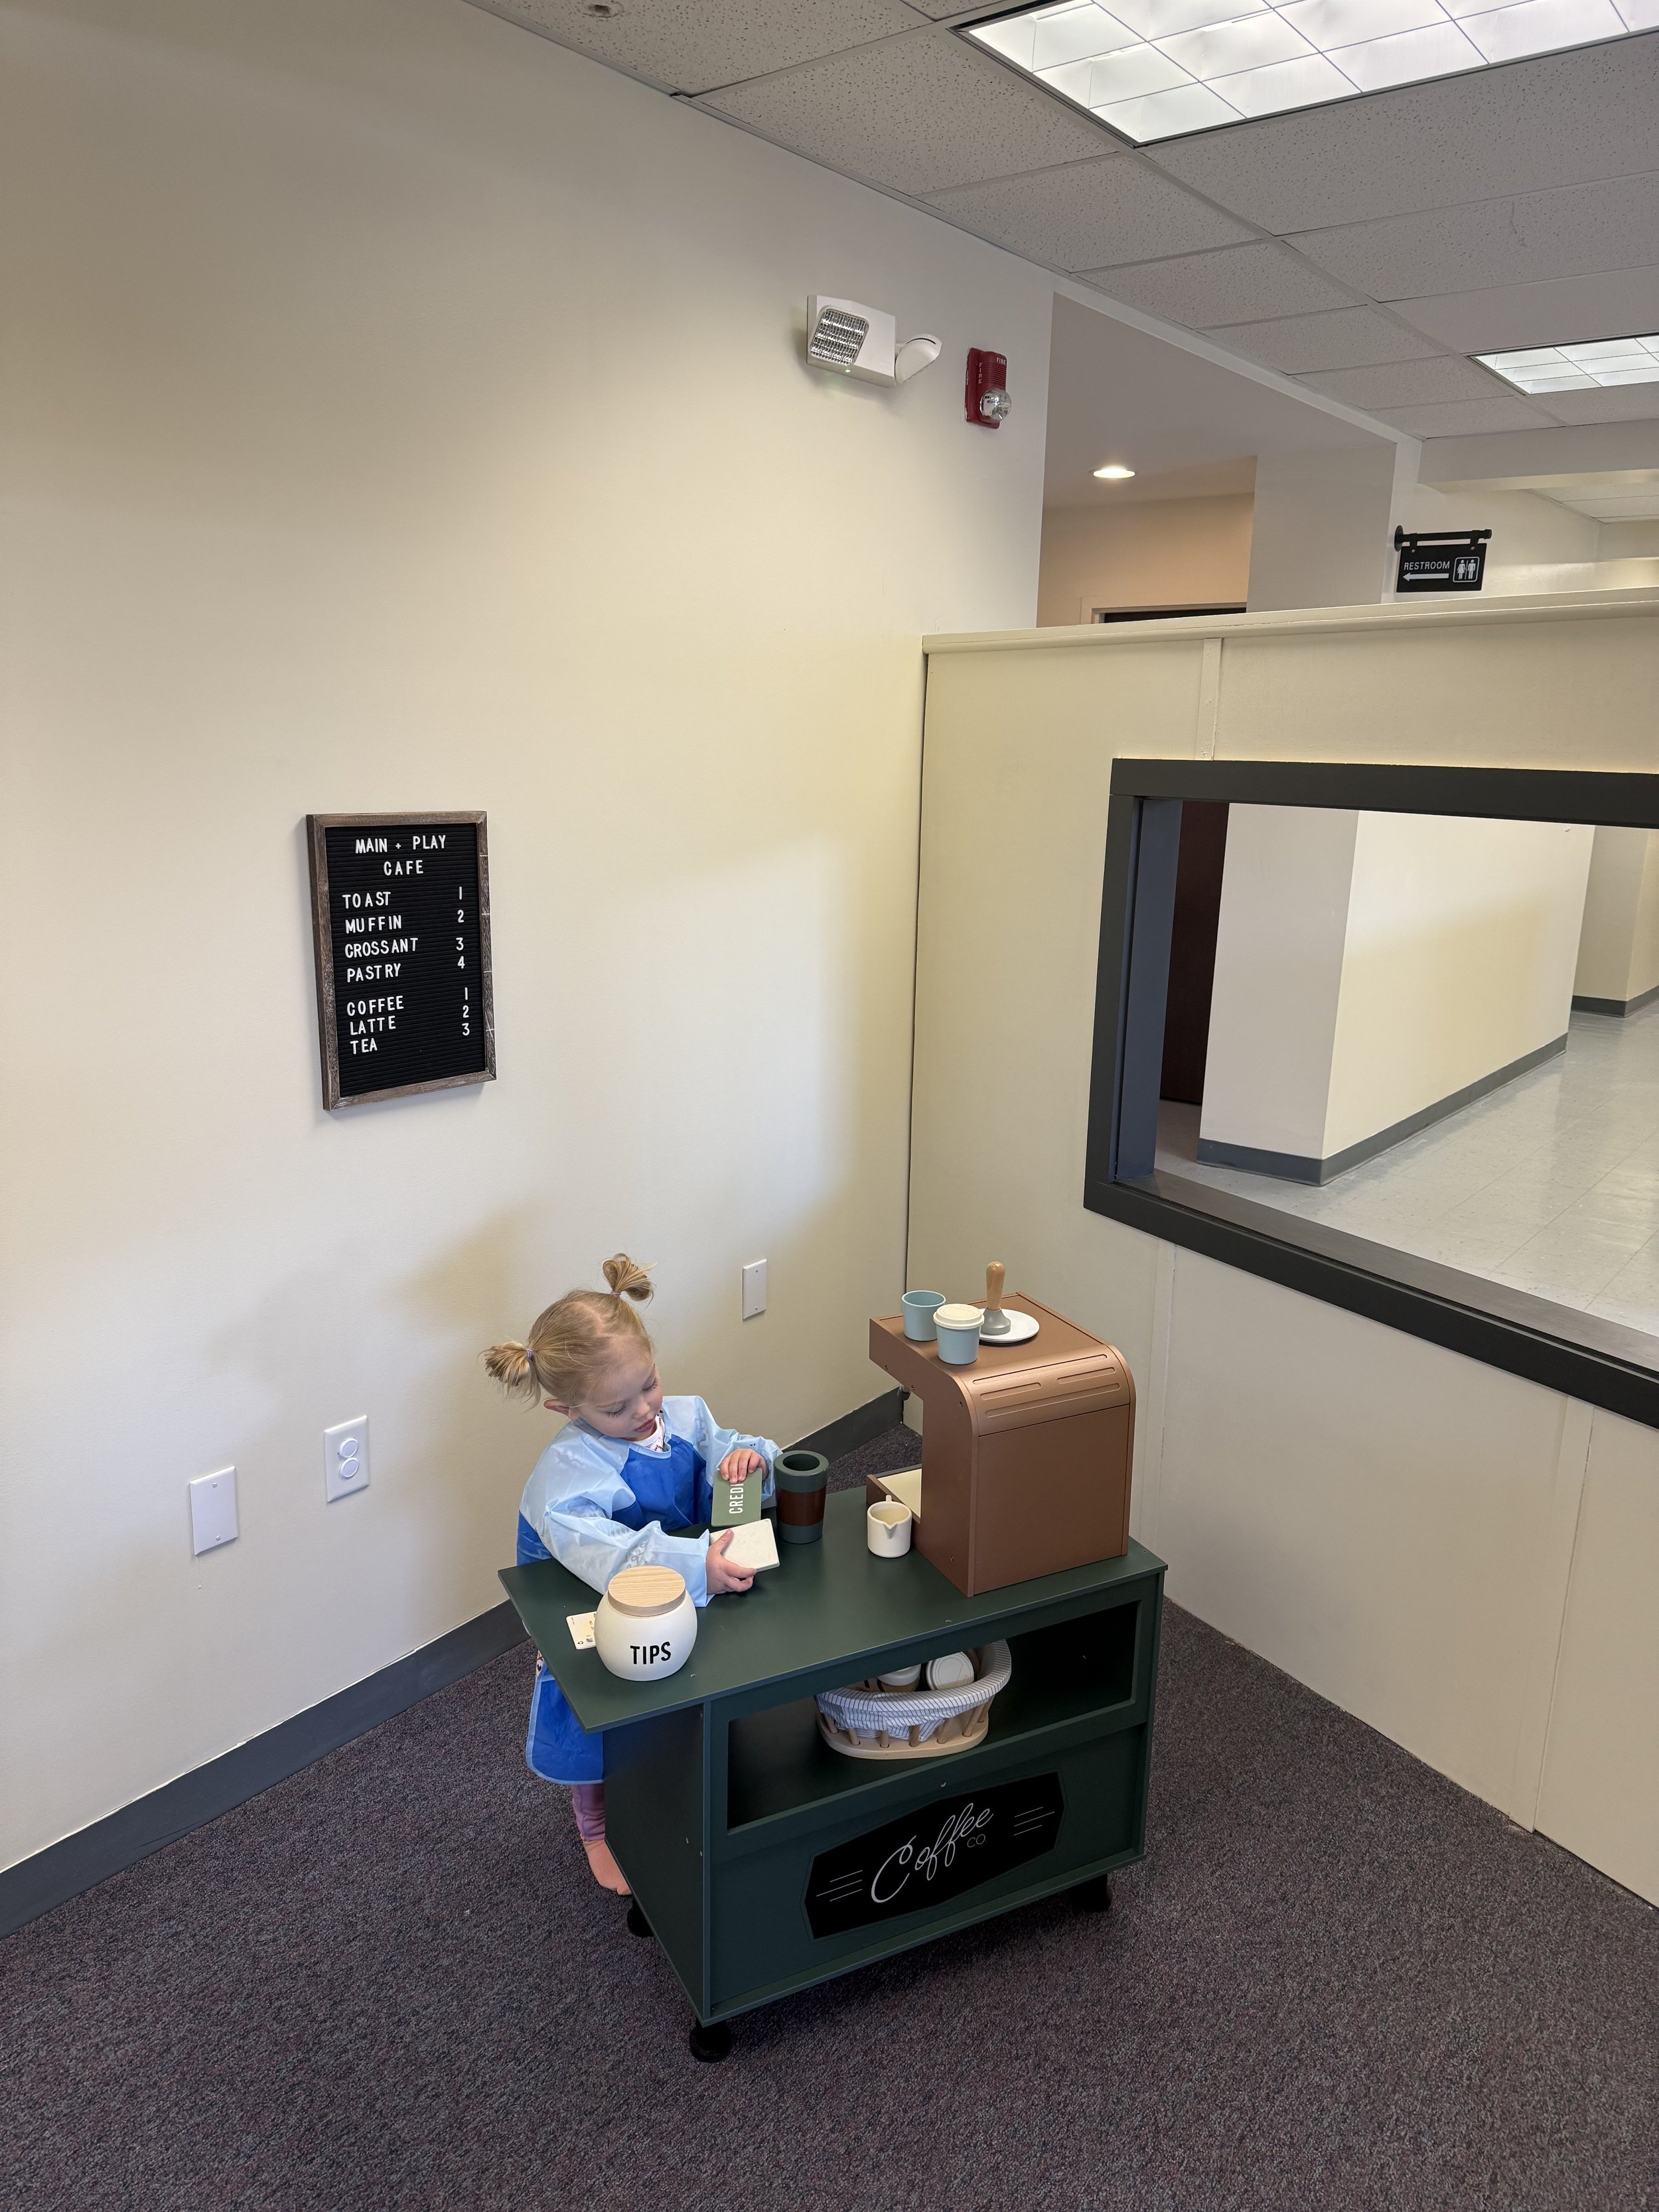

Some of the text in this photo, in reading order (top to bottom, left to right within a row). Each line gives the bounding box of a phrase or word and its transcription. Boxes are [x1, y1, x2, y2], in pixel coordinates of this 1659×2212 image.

[1404, 561, 1450, 571] RESTROOM
[355, 838, 388, 854] MAIN
[412, 835, 446, 850] PLAY
[383, 860, 424, 876] CAFE
[342, 891, 392, 909] TOAST
[345, 909, 465, 934] MUFFIN 2
[344, 937, 464, 958] CROSSANT 3
[347, 955, 465, 983] PASTRY 4
[346, 995, 404, 1017] COFFEE
[350, 1005, 470, 1036] LATTE 2
[349, 1022, 470, 1055] TEA 3
[729, 1483, 744, 1514] CREDI
[630, 1641, 672, 1665] TIPS
[871, 1803, 994, 1903] Coffee
